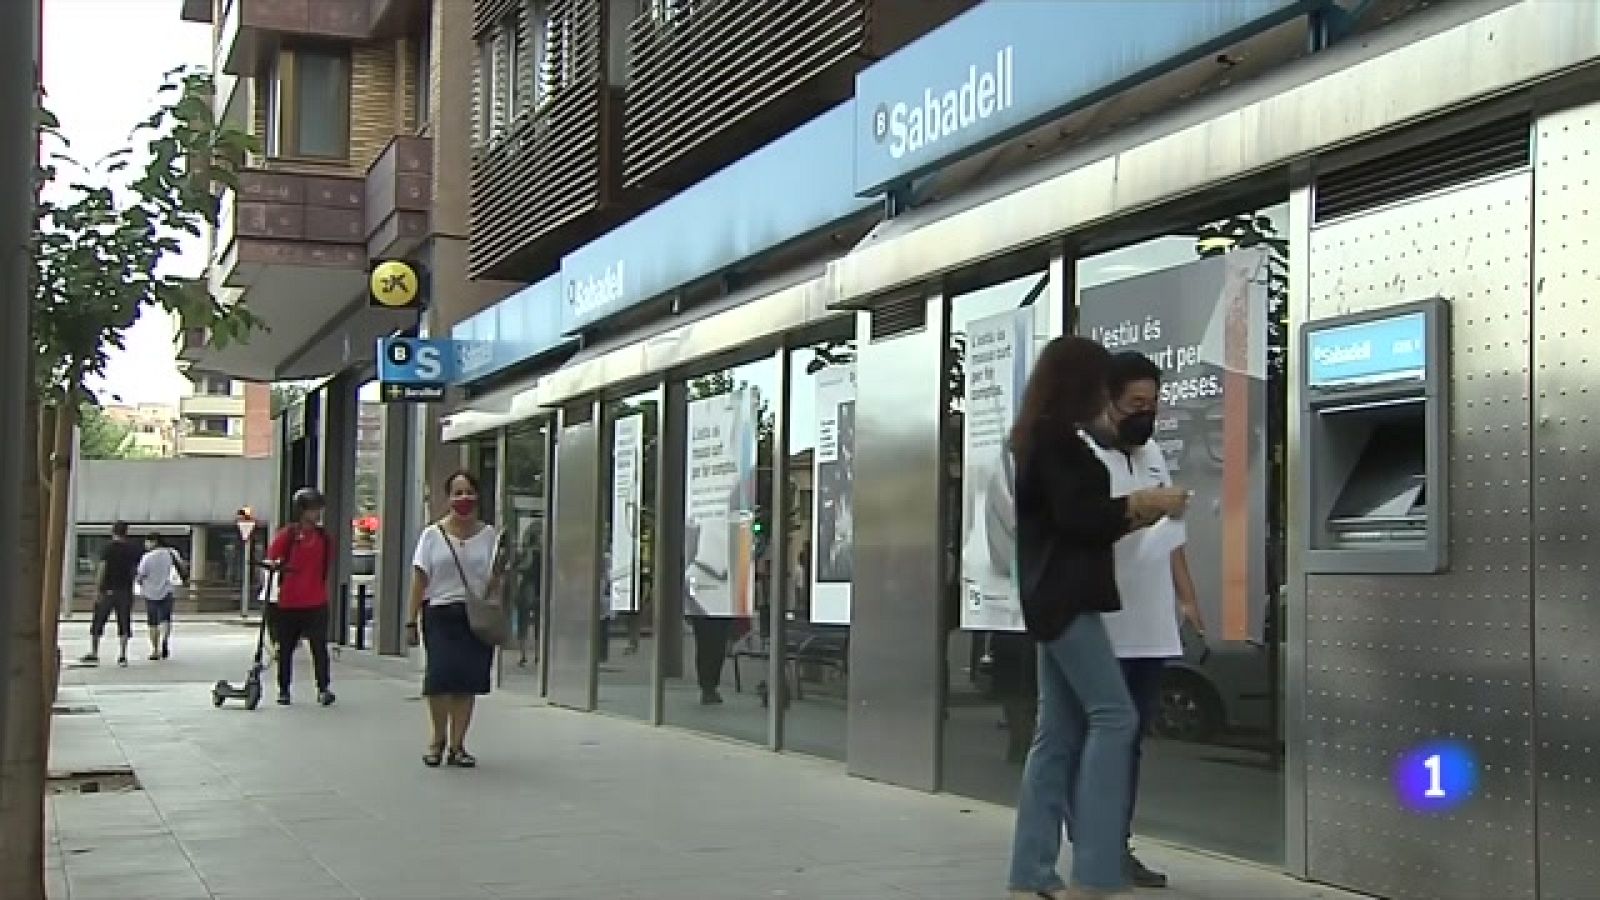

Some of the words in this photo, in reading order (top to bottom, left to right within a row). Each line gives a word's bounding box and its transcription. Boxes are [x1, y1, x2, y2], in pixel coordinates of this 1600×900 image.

[889, 44, 1014, 159] Sabadell
[1144, 314, 1161, 341] és
[415, 346, 443, 380] S
